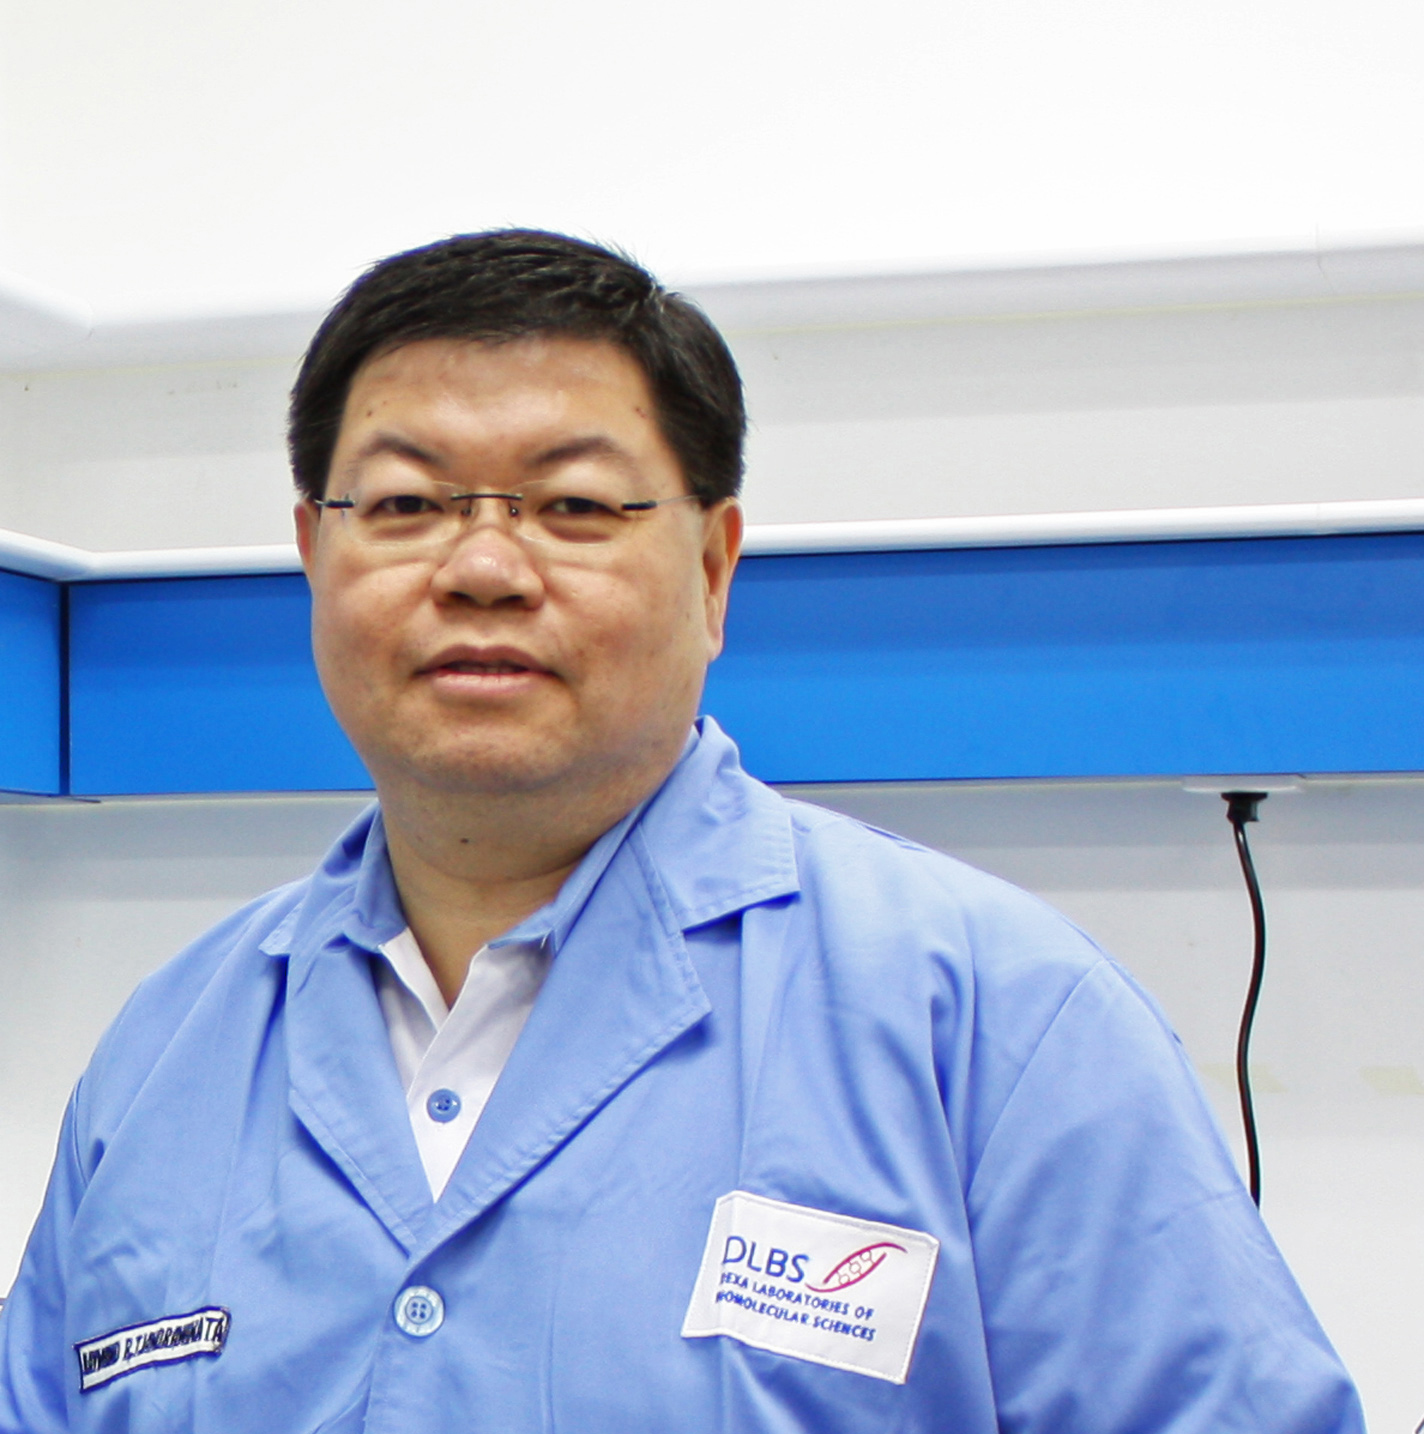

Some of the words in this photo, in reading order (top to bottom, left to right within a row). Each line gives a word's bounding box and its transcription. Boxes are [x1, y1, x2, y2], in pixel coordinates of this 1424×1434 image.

[721, 1235, 810, 1283] DLBS
[752, 1281, 850, 1316] LABORATORIES
[854, 1306, 875, 1321] OF
[813, 1315, 877, 1342] SCIENCES
